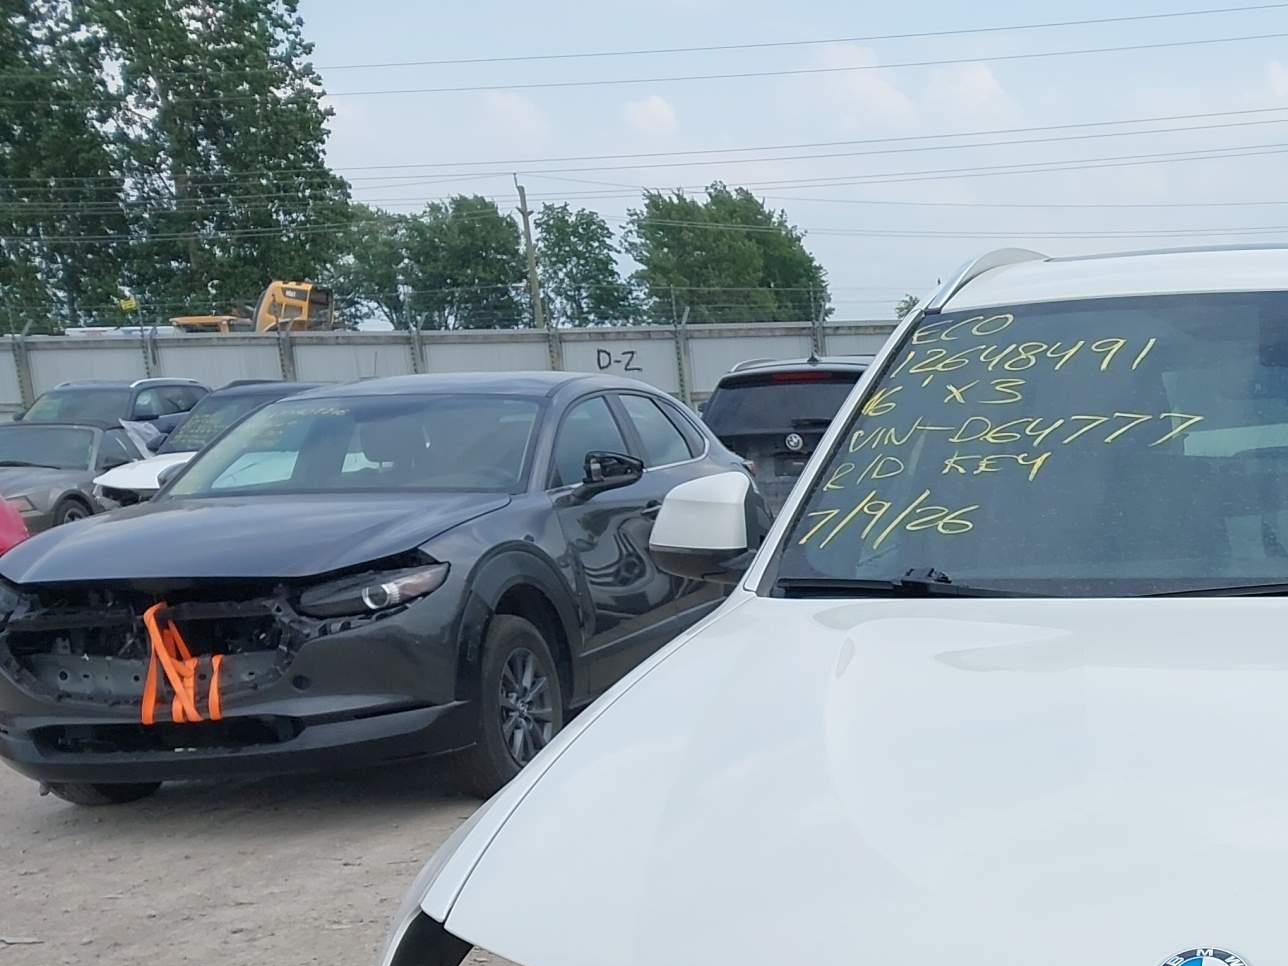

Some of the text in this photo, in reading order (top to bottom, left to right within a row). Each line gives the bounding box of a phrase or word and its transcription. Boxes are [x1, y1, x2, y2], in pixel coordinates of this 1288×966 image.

[911, 313, 1014, 345] ECO
[597, 349, 643, 371] D-Z
[889, 337, 1157, 379] 12648491
[823, 451, 1052, 491] R/D KEY
[799, 489, 980, 549] 7/9/26
